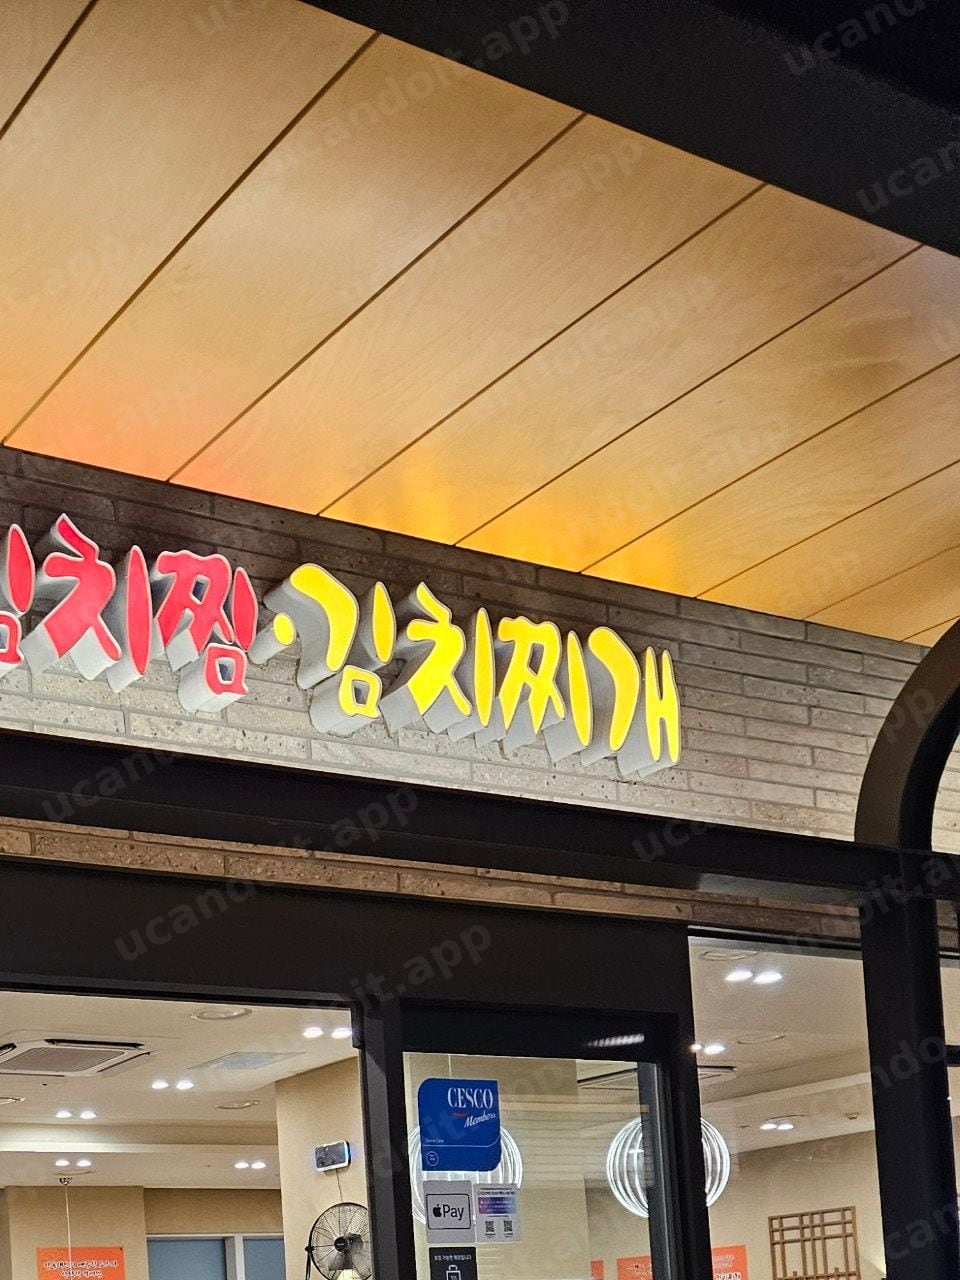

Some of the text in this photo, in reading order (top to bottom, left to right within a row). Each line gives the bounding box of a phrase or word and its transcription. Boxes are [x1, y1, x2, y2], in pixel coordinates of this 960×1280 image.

[447, 1086, 494, 1109] CESCO
[463, 1111, 496, 1128] Members
[443, 1204, 464, 1221] Pay
